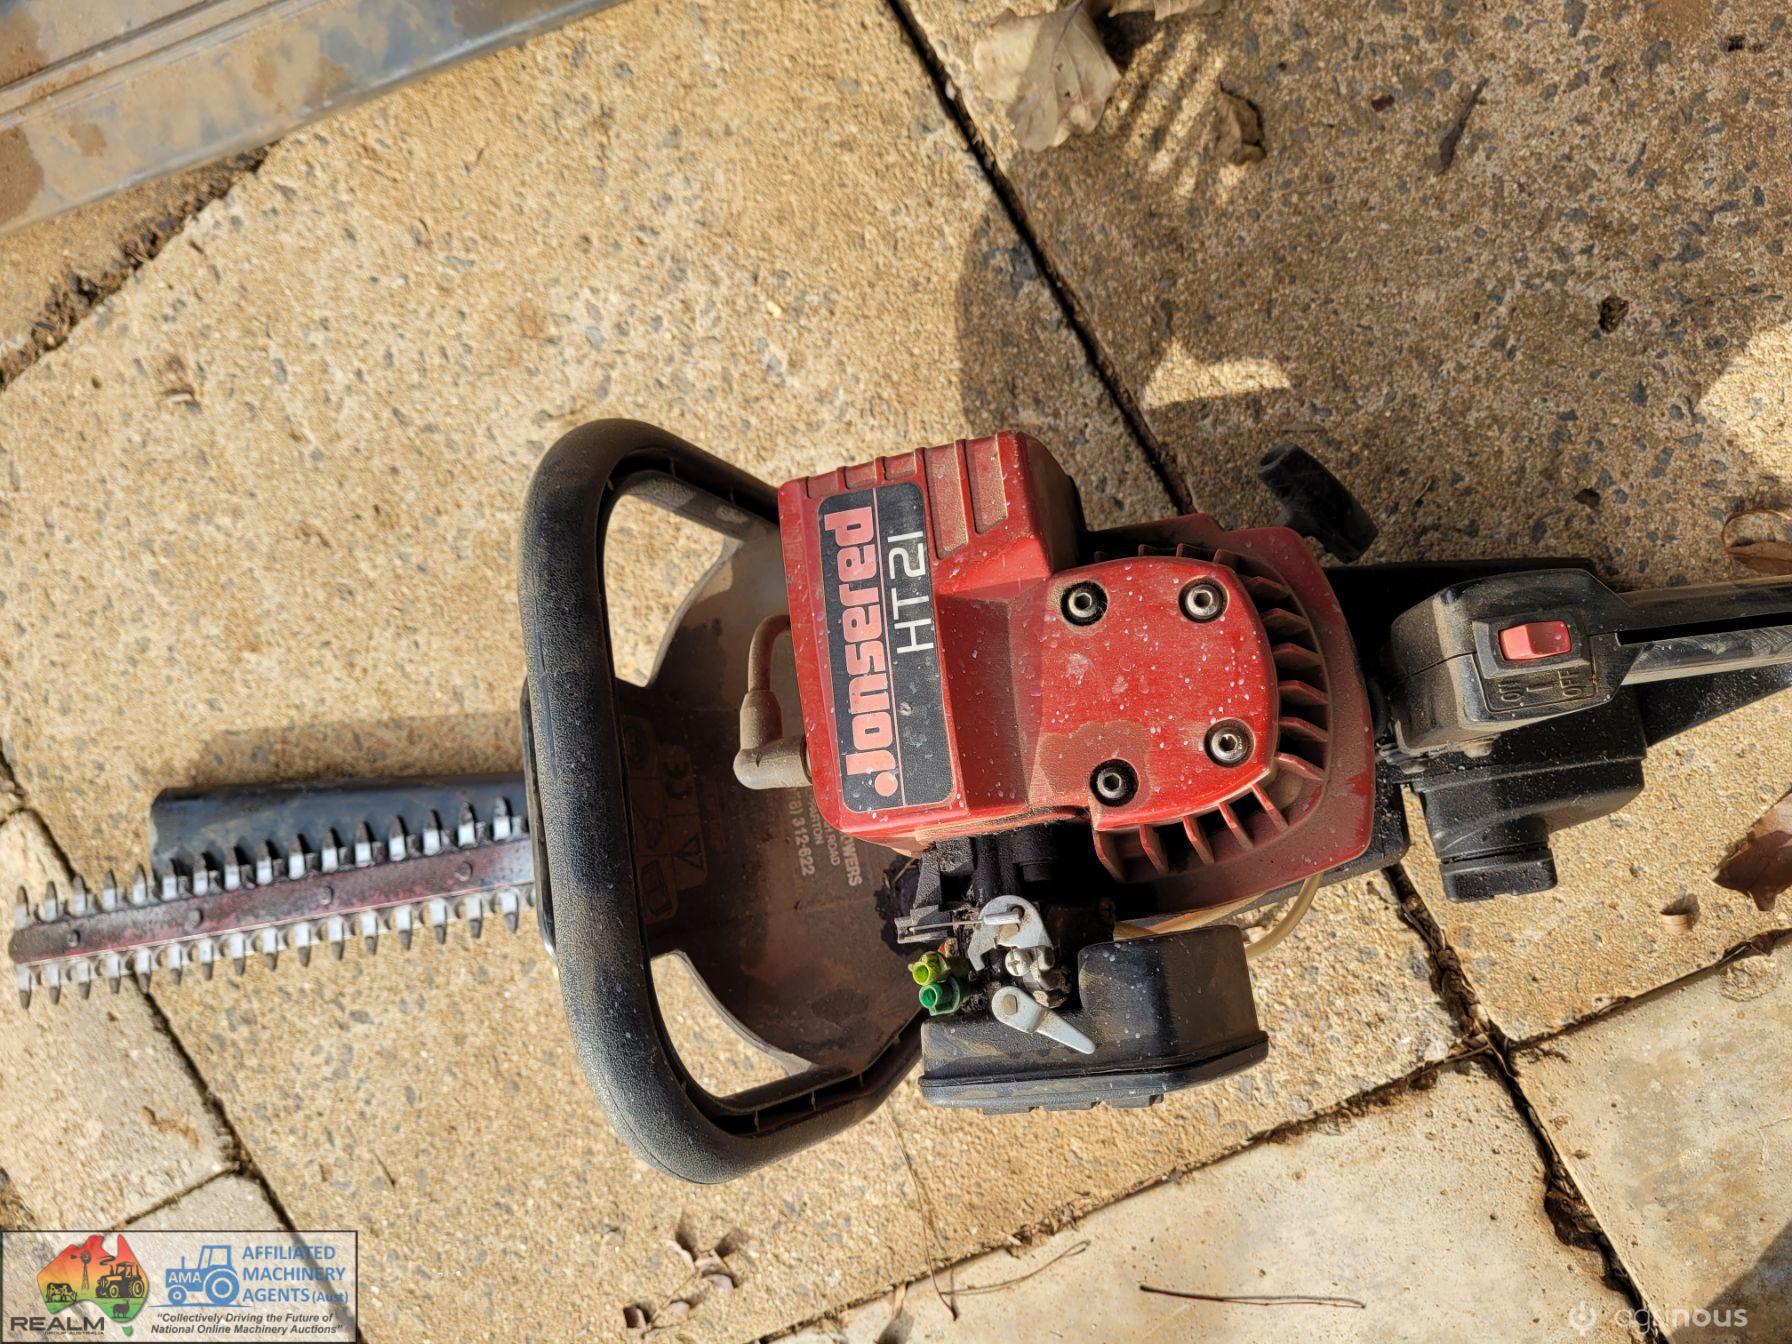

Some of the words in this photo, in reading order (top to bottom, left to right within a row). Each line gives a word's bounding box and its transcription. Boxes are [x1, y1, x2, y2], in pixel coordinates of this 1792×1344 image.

[823, 506, 898, 797] Jonsered
[792, 817, 816, 877] 312-622
[826, 833, 840, 866] ROAD
[840, 834, 863, 887] OWERS
